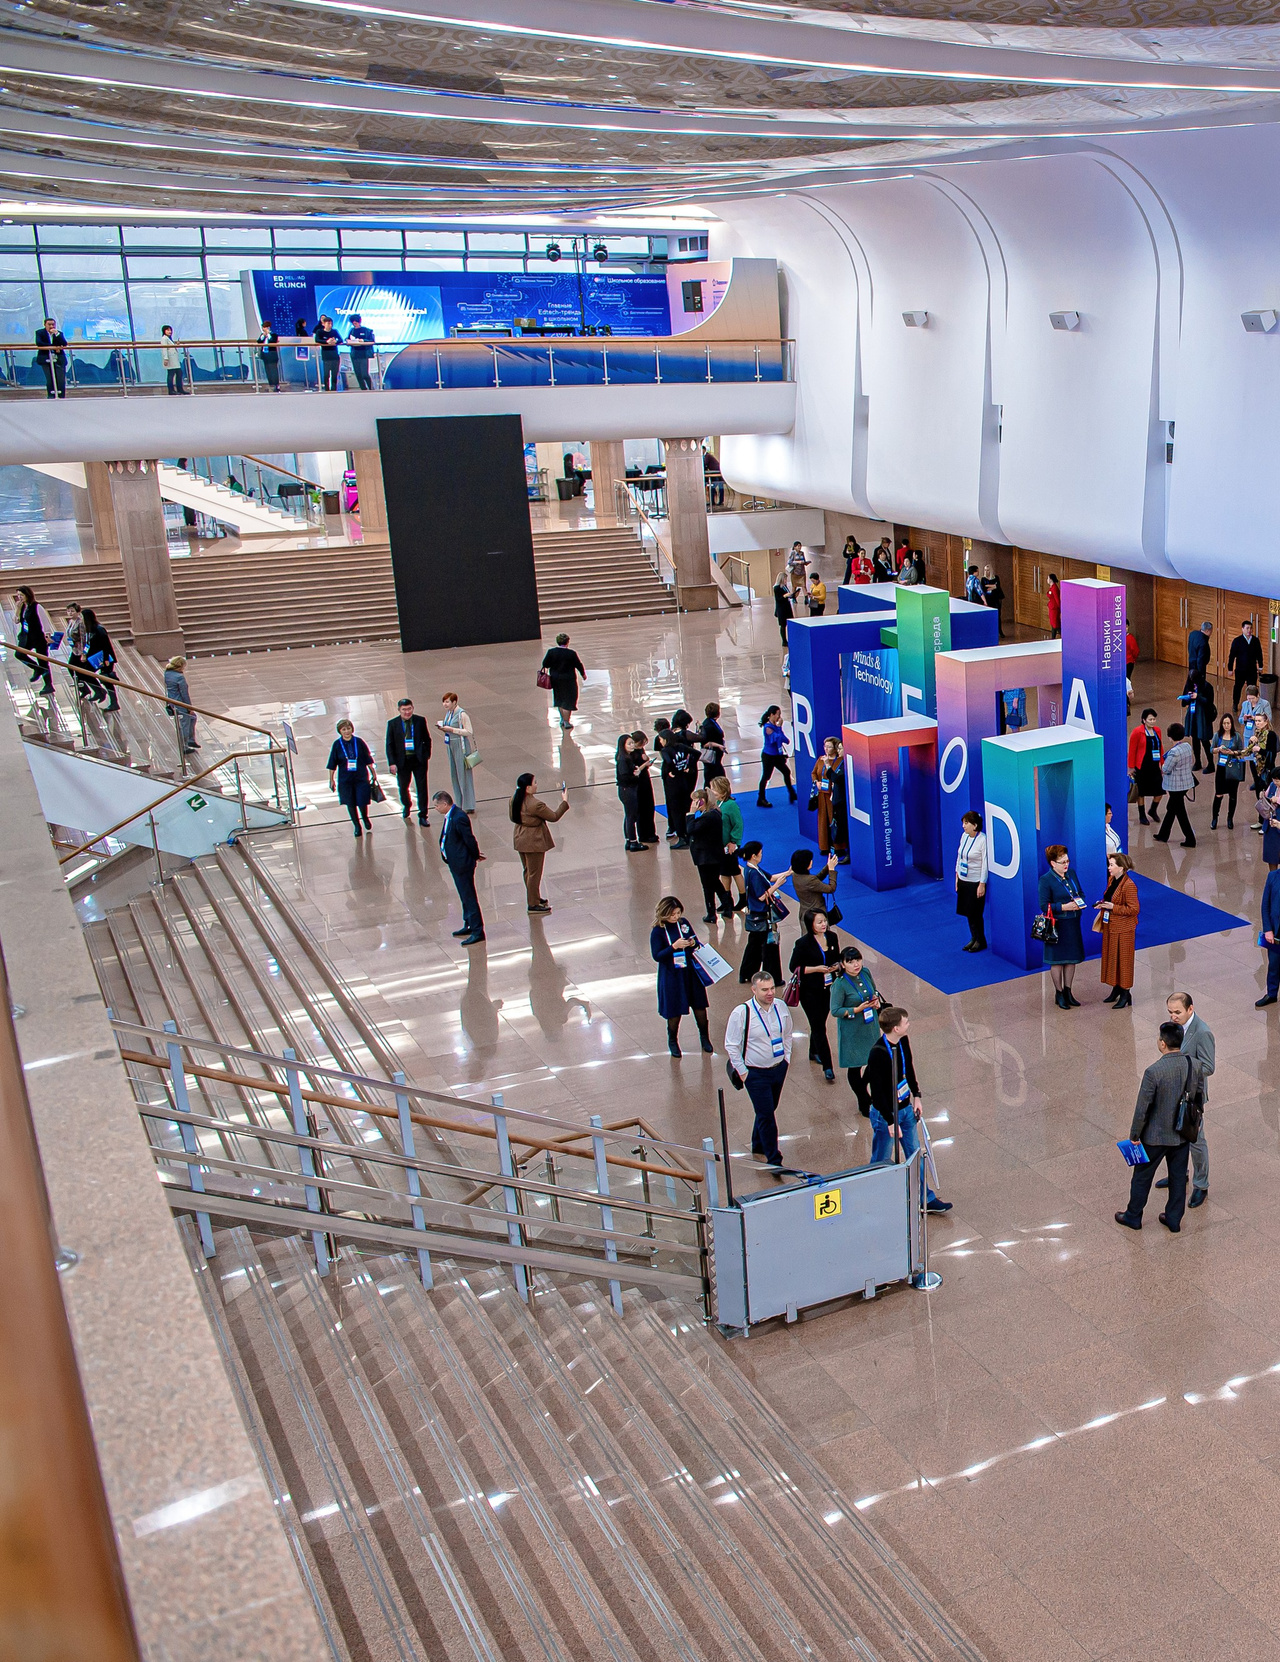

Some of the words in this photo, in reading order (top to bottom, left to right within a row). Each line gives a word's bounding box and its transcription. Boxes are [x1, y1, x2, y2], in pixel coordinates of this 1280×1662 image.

[273, 281, 307, 289] CRUNCH
[1114, 595, 1122, 626] века
[932, 616, 943, 652] среда
[1101, 620, 1111, 670] Навыки
[852, 651, 874, 668] Minds
[874, 655, 881, 671] &
[853, 664, 894, 695] Technology
[1065, 677, 1095, 734] A
[791, 691, 816, 759] R
[939, 736, 967, 794] O
[846, 753, 870, 826] L
[881, 794, 889, 809] the
[882, 811, 890, 827] and
[884, 828, 893, 867] Learning
[984, 801, 1021, 880] D
